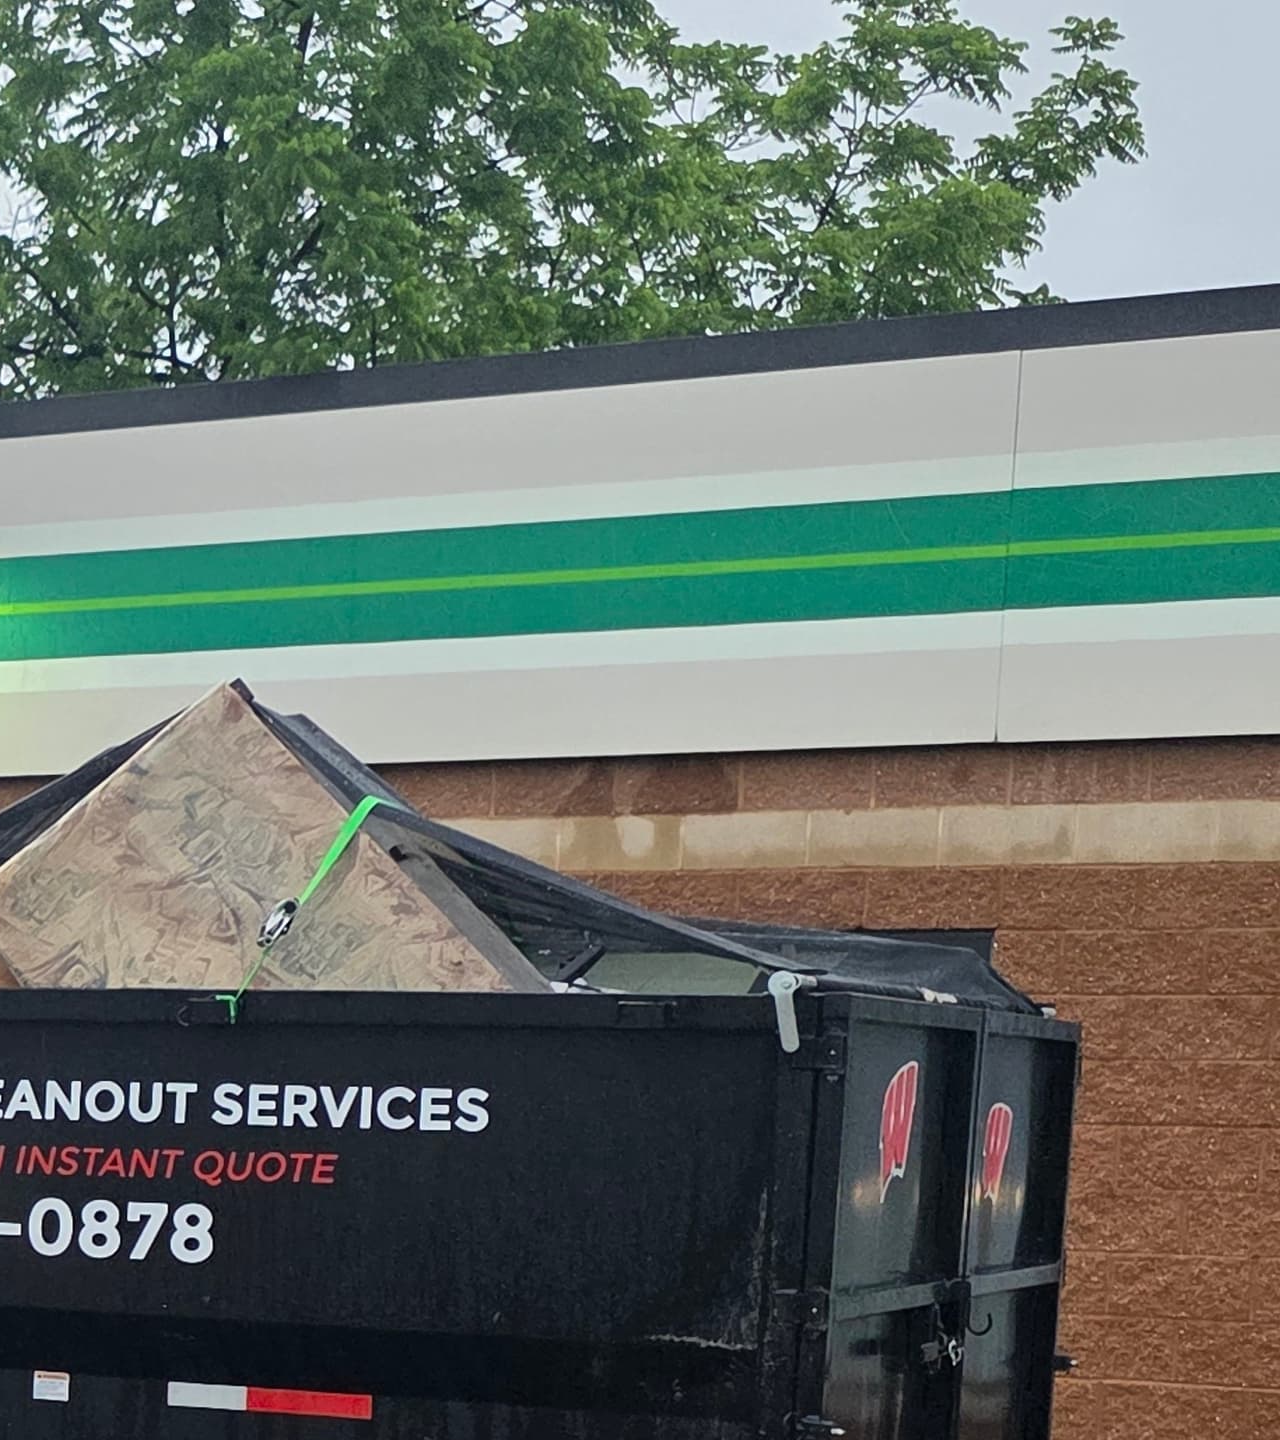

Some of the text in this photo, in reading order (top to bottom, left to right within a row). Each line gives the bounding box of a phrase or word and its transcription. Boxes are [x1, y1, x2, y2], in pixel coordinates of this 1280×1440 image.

[210, 1082, 490, 1133] SERVICES
[15, 1145, 185, 1179] INSTANT
[193, 1150, 339, 1187] QUOTE
